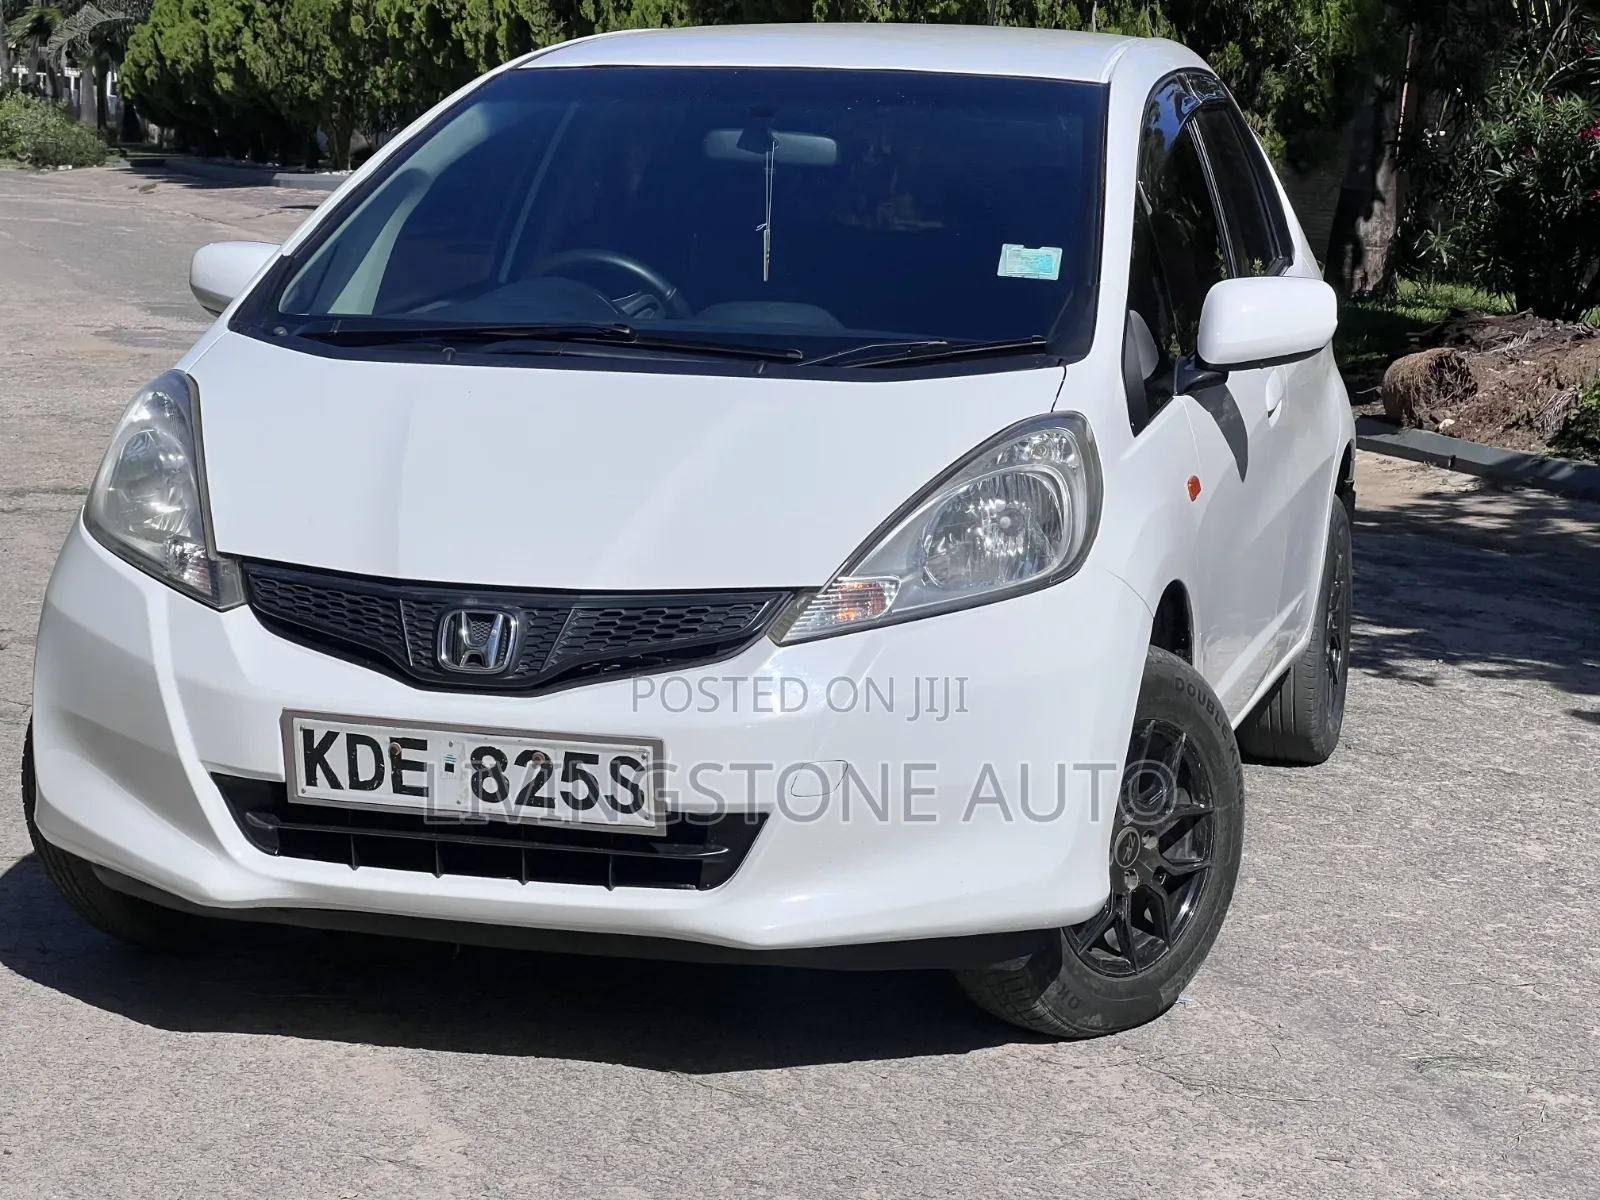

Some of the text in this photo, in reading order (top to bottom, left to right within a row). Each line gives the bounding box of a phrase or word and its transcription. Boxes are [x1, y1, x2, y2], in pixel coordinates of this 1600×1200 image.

[1174, 676, 1230, 740] DOUBLE
[302, 728, 646, 815] KDE 825S
